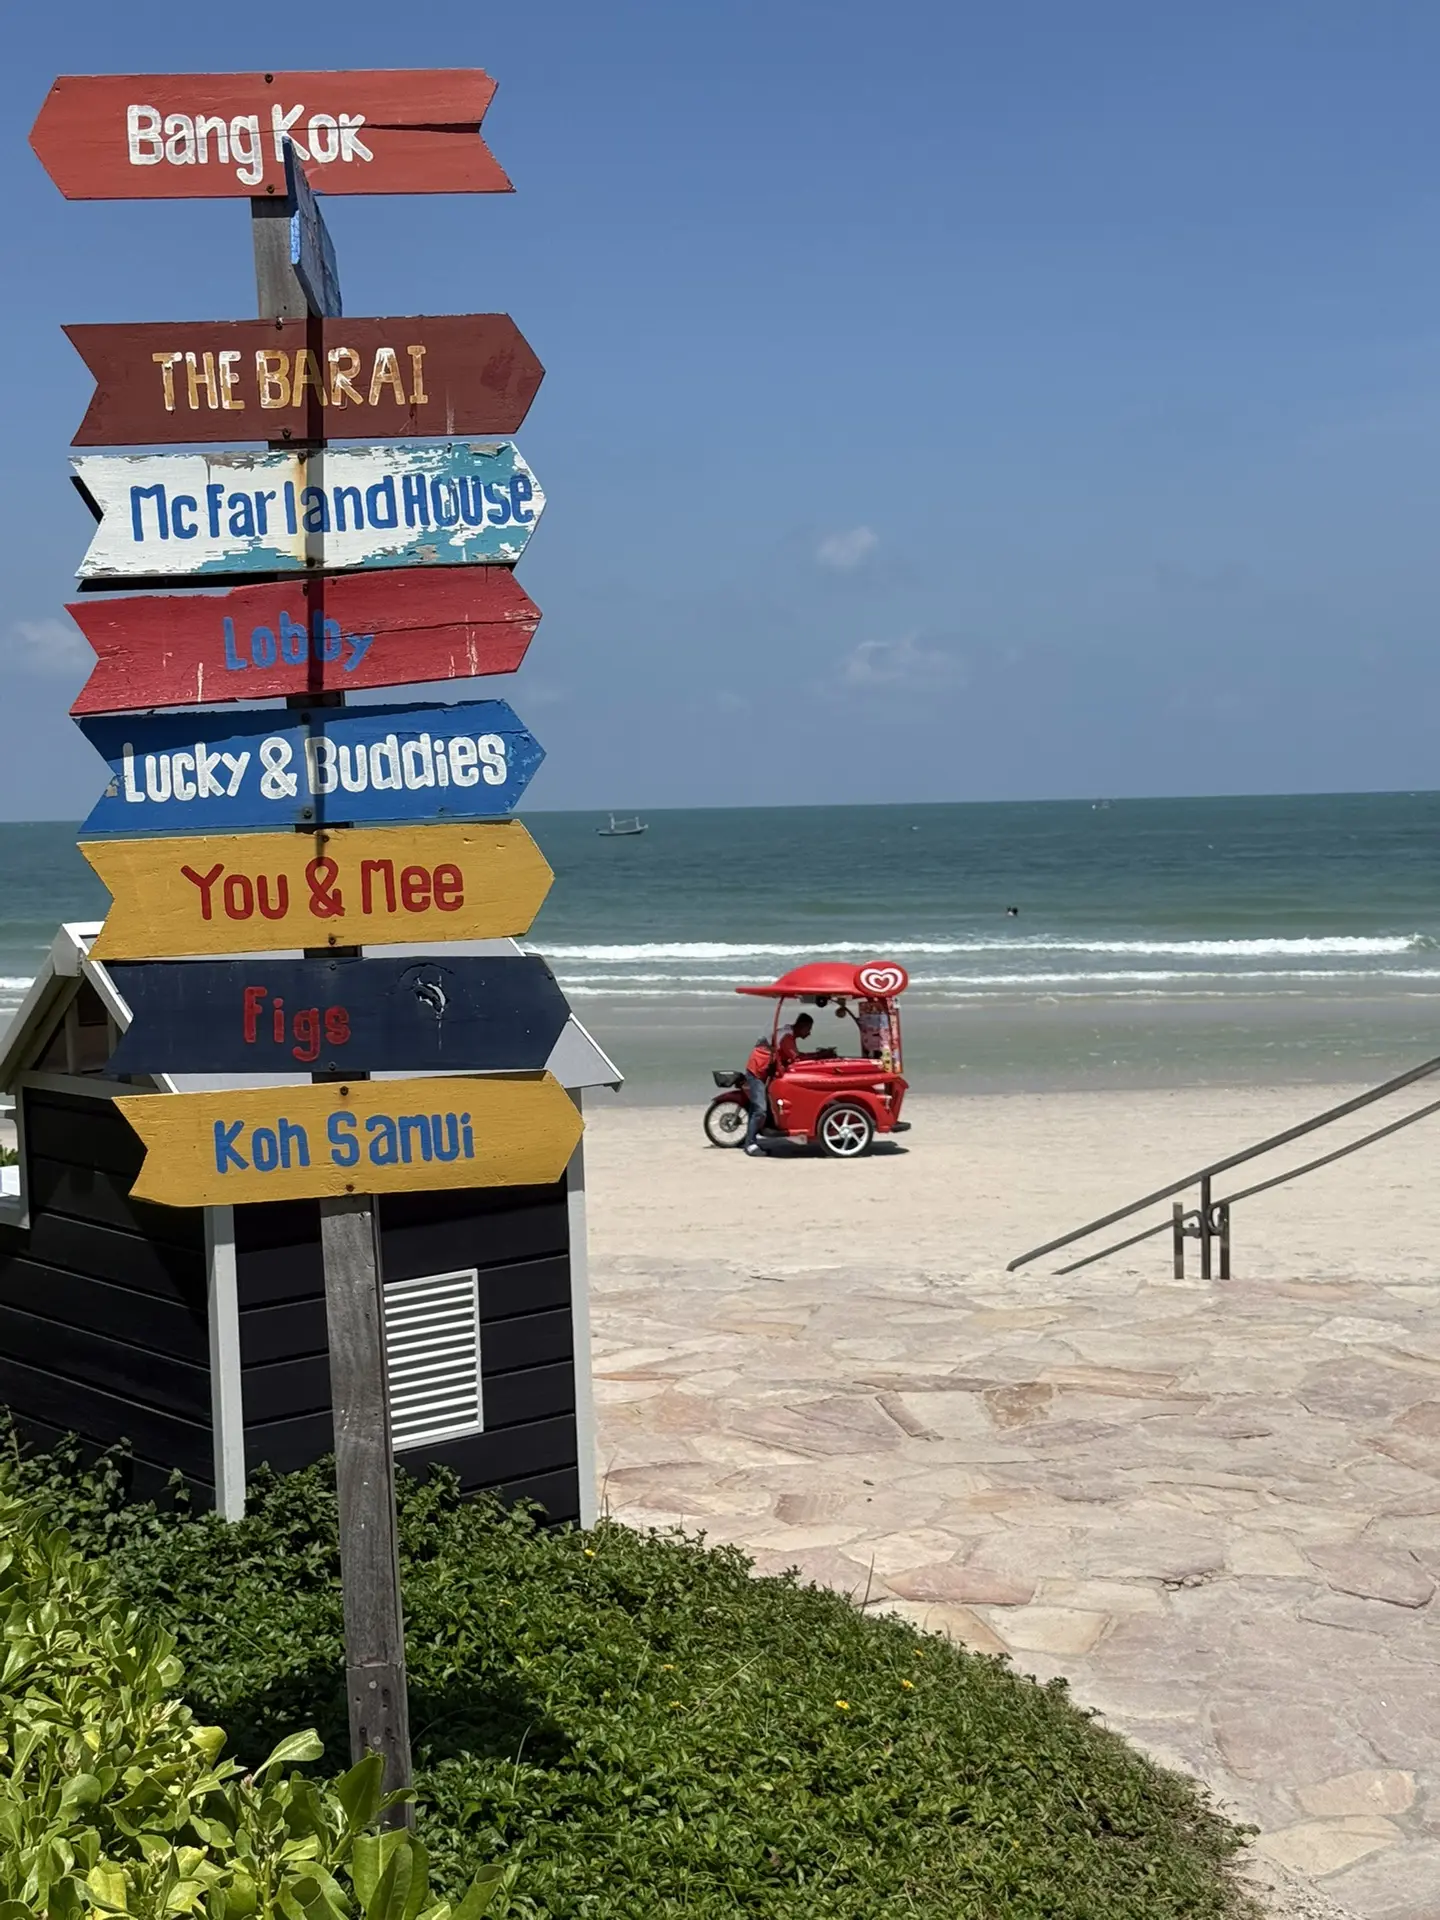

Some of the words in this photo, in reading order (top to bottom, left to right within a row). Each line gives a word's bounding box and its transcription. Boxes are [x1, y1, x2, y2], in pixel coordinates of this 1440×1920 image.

[127, 104, 263, 185] Bang
[152, 351, 245, 411] THE
[256, 346, 429, 409] BARAI
[223, 611, 374, 671] Lobby
[123, 742, 251, 802] Lucky
[259, 736, 298, 800] &
[304, 733, 508, 796] Buddies
[181, 863, 289, 920] You
[305, 856, 345, 918] &
[360, 859, 464, 914] Mee
[244, 986, 351, 1062] Figs
[214, 1117, 310, 1173] Koh
[327, 1110, 475, 1168] Samui
